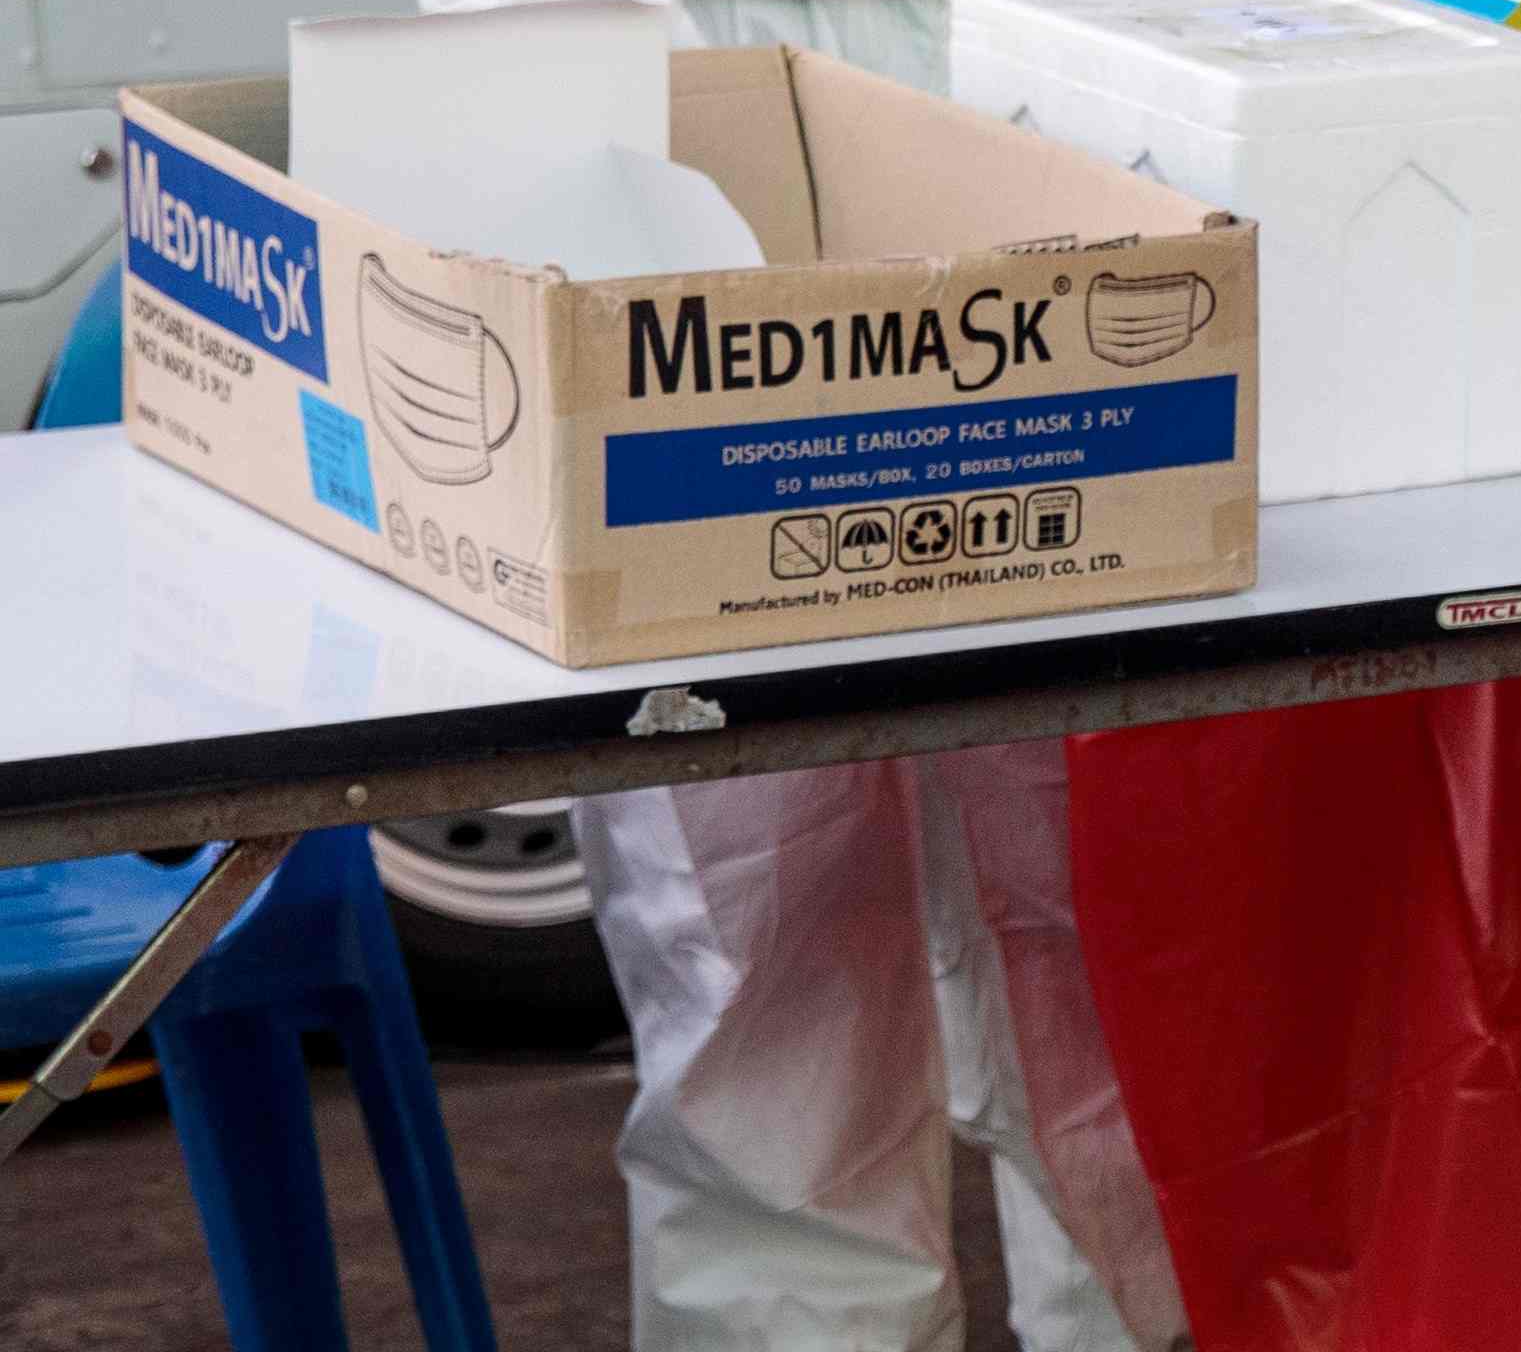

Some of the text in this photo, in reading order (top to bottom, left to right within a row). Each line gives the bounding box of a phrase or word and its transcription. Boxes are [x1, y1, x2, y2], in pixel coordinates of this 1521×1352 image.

[722, 406, 1136, 466] DISPOSABLE EARLOOP FACE MASK 3 PLY
[775, 449, 1086, 496] 50 MASKS/BOX, 20 BOXES/CARTON
[720, 553, 1125, 616] Manufactured by MED-CON (THAILAND) CO., LTD.
